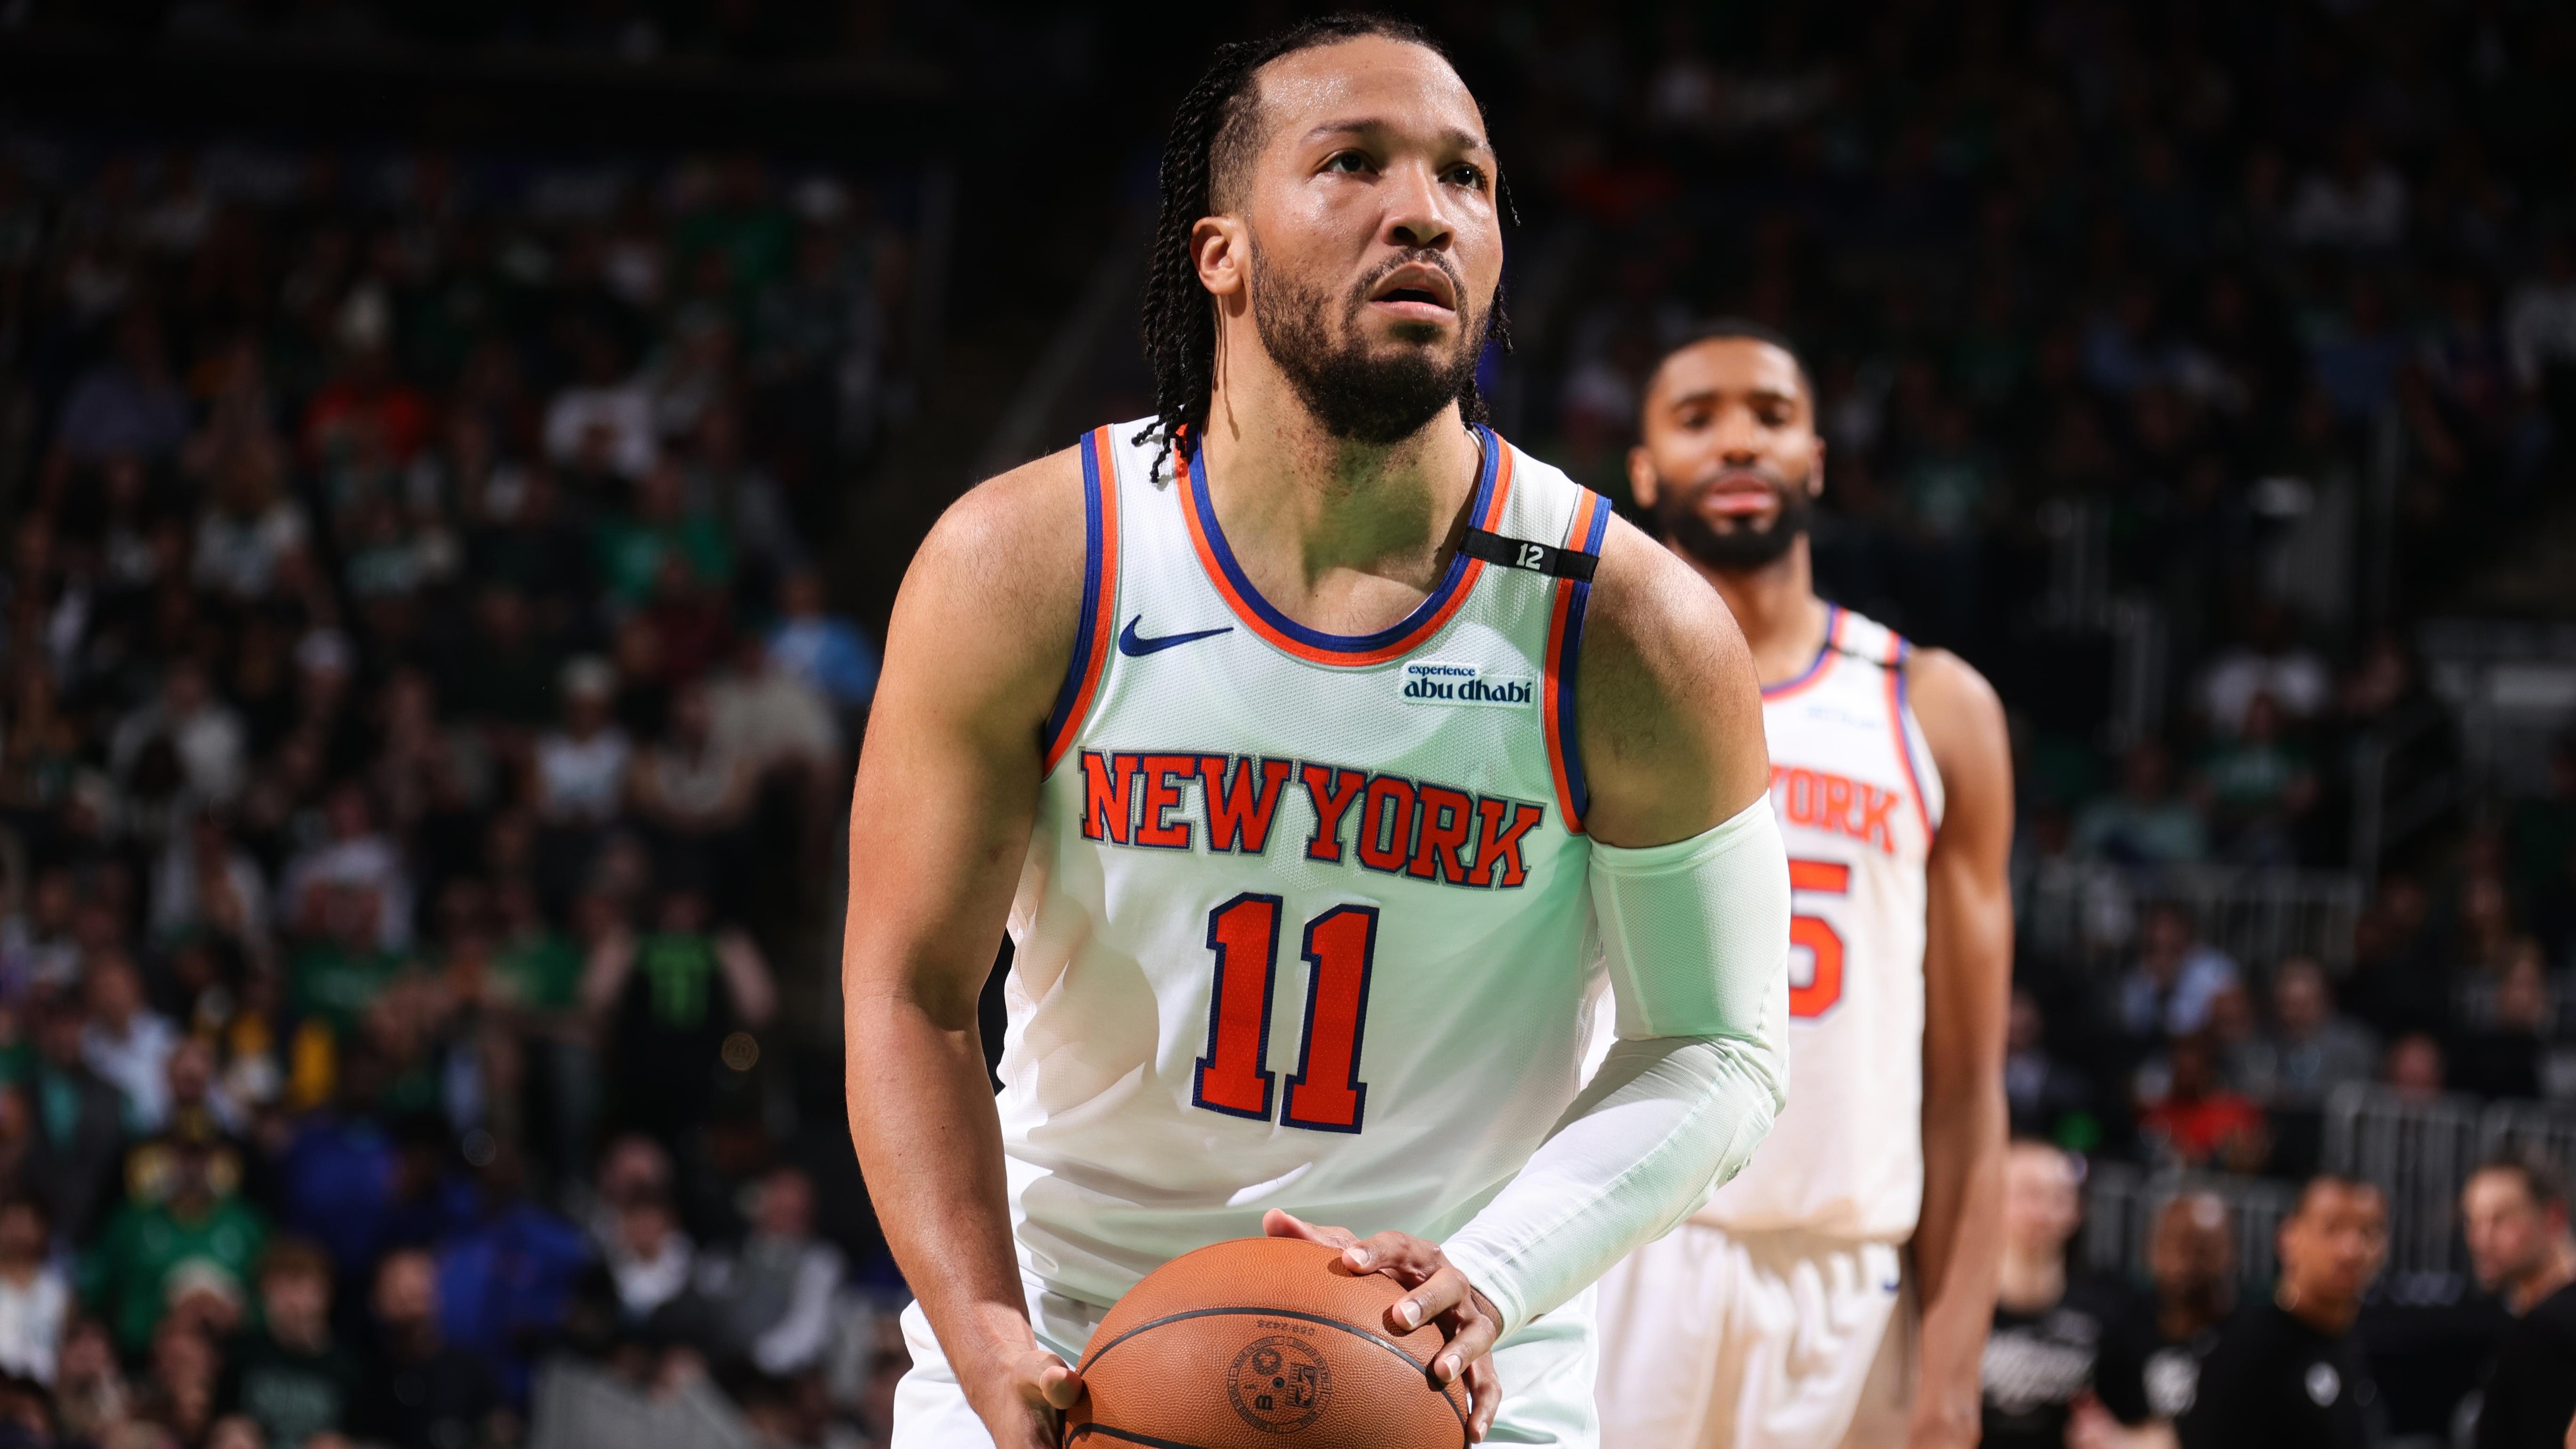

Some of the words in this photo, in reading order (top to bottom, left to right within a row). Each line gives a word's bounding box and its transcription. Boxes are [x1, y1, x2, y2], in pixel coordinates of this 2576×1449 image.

[1516, 543, 1544, 570] 12
[1408, 665, 1476, 677] experience
[1404, 677, 1453, 699] abu
[1458, 679, 1532, 703] dhabi
[1078, 747, 1292, 854] NEW
[1299, 760, 1547, 891] YORK
[1192, 892, 1380, 1134] 11
[1233, 1352, 1248, 1369] MADE
[1247, 1345, 1255, 1354] IN
[1255, 1338, 1276, 1349] CHINA
[1293, 1340, 1316, 1357] INFLATE
[1229, 1384, 1238, 1399] USA
[1234, 1399, 1243, 1407] IN
[1238, 1407, 1268, 1429] DESIGNED
